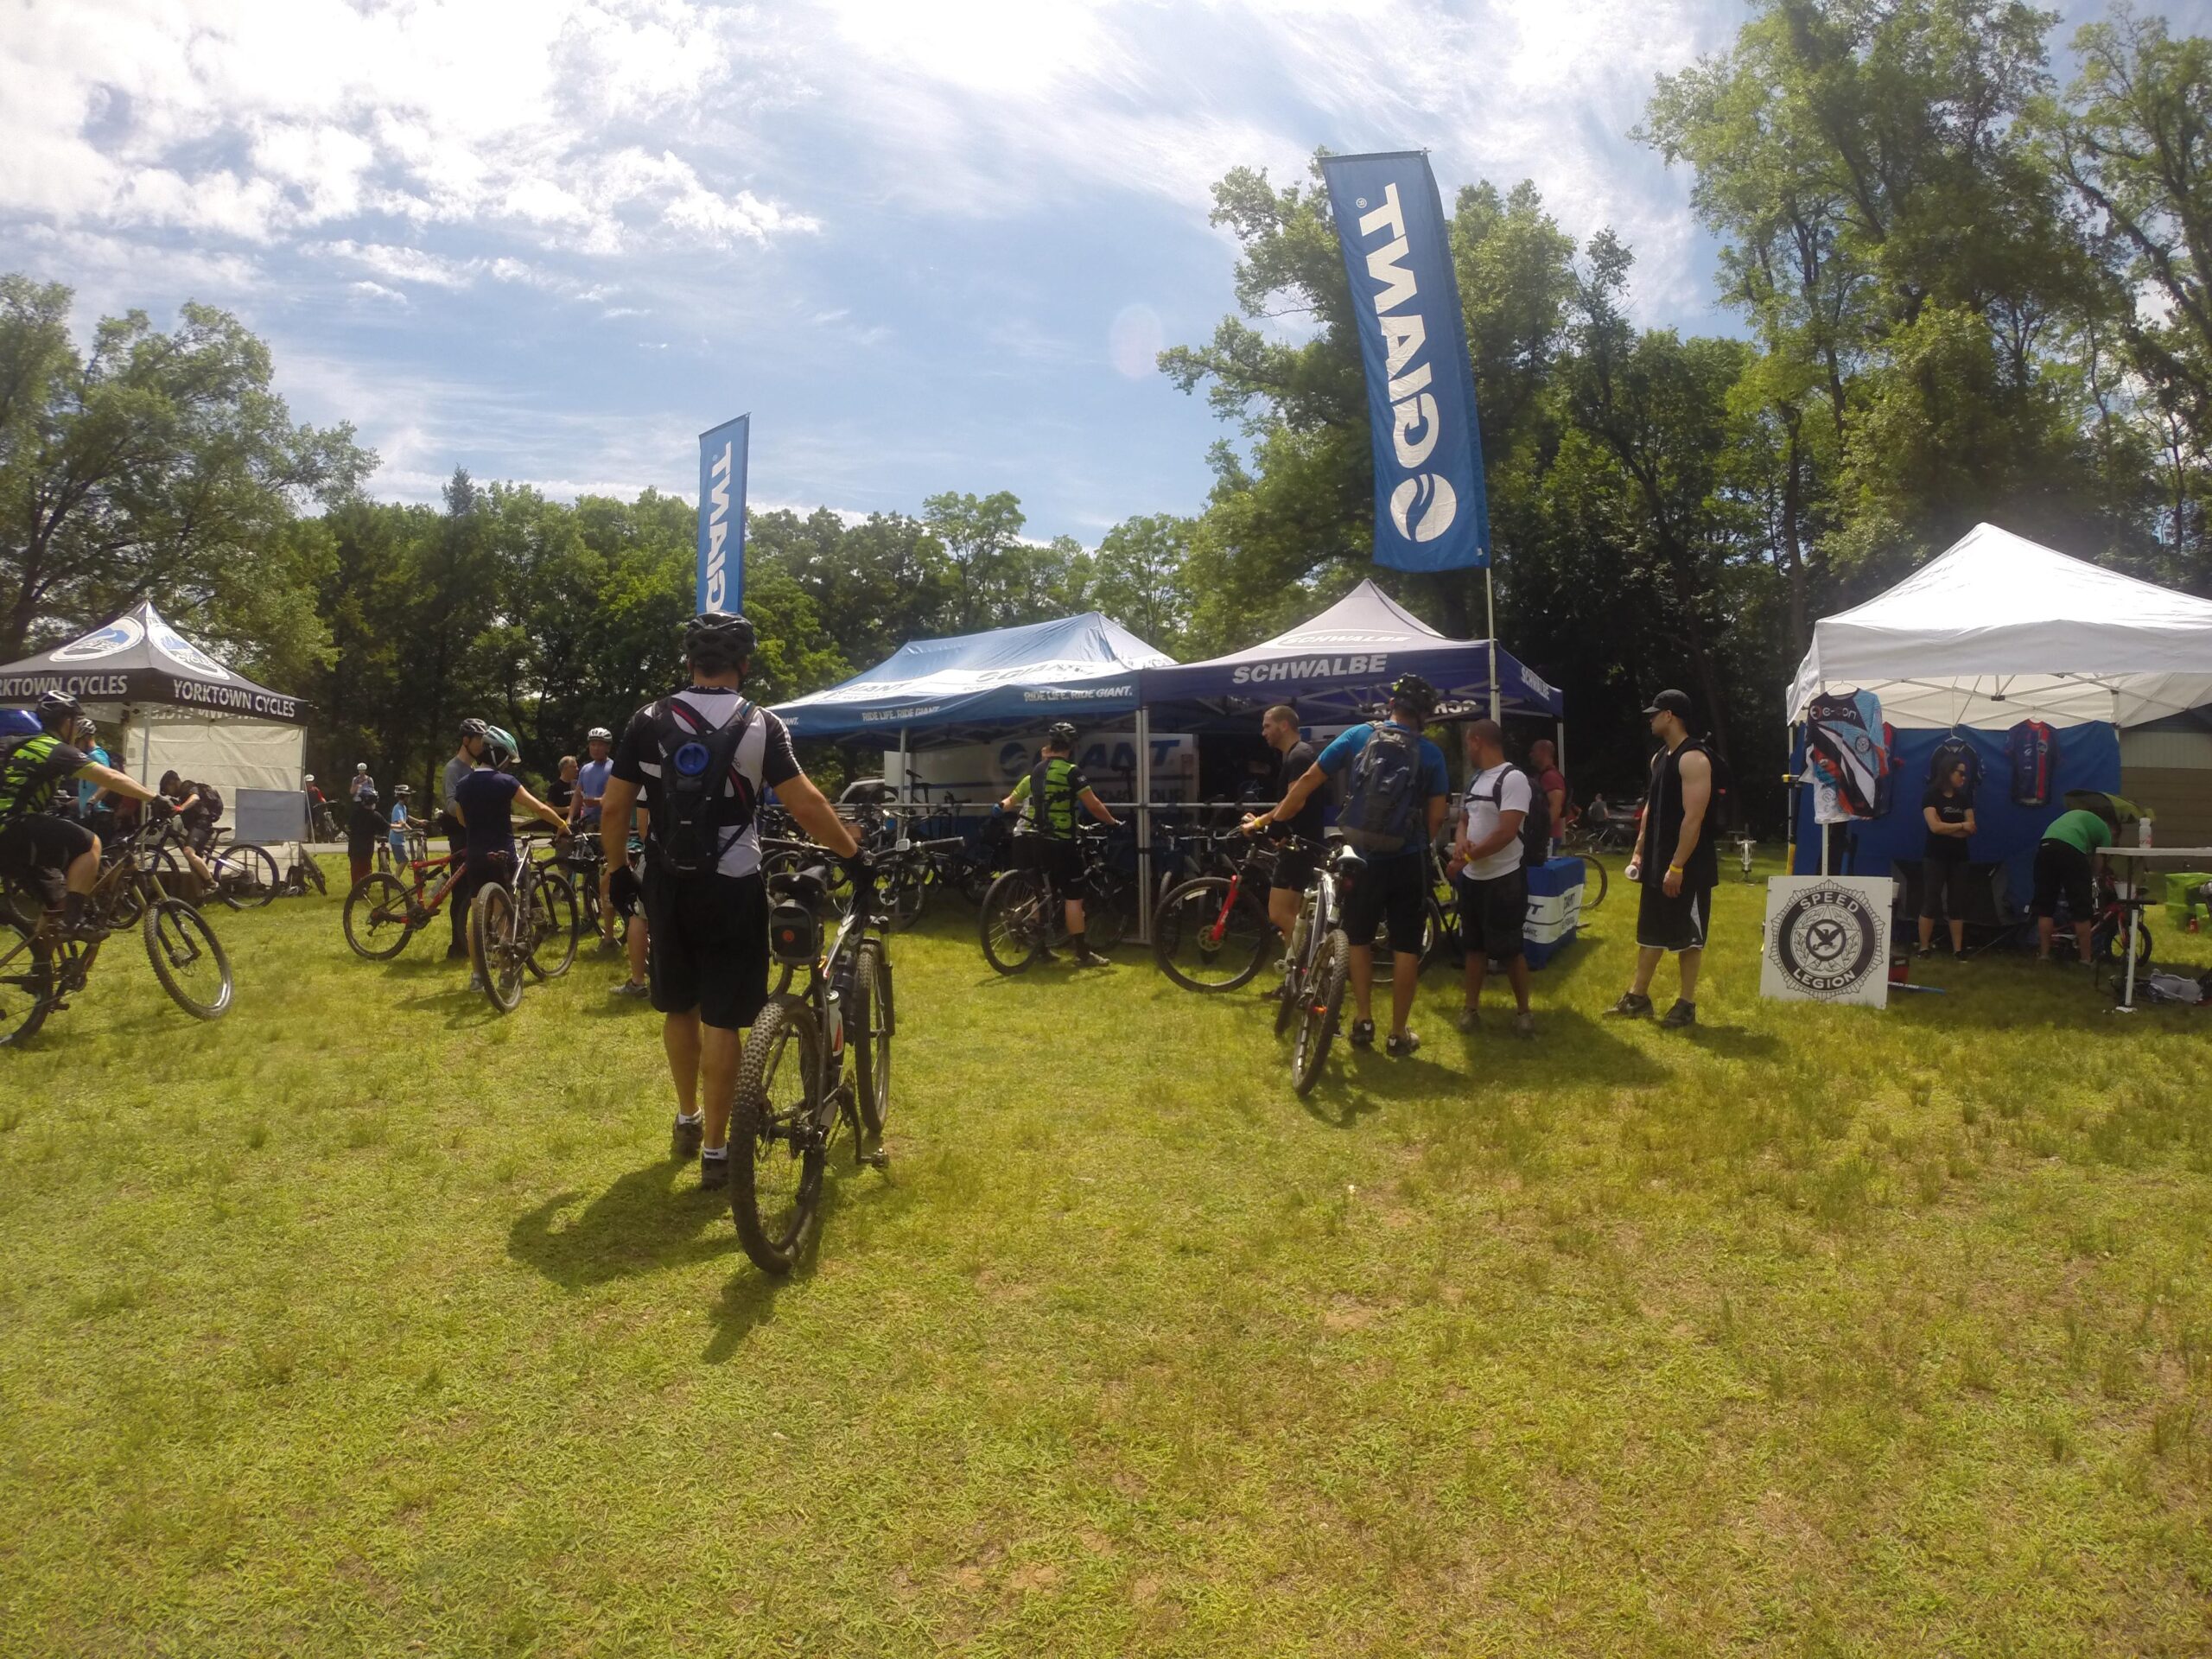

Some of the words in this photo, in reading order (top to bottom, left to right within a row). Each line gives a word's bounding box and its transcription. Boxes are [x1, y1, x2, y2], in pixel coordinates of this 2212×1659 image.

[1359, 182, 1439, 469] GIANT
[706, 441, 732, 613] GIANT
[1232, 654, 1388, 684] SCHWALBE
[0, 677, 63, 696] KTOWN
[67, 675, 128, 696] CYCLES
[1096, 685, 1133, 698] GIANT.
[174, 679, 252, 710] YORKTOWN
[255, 696, 296, 718] CYCLES
[1800, 892, 1859, 913] SPEED
[1793, 968, 1855, 988] LEGION
